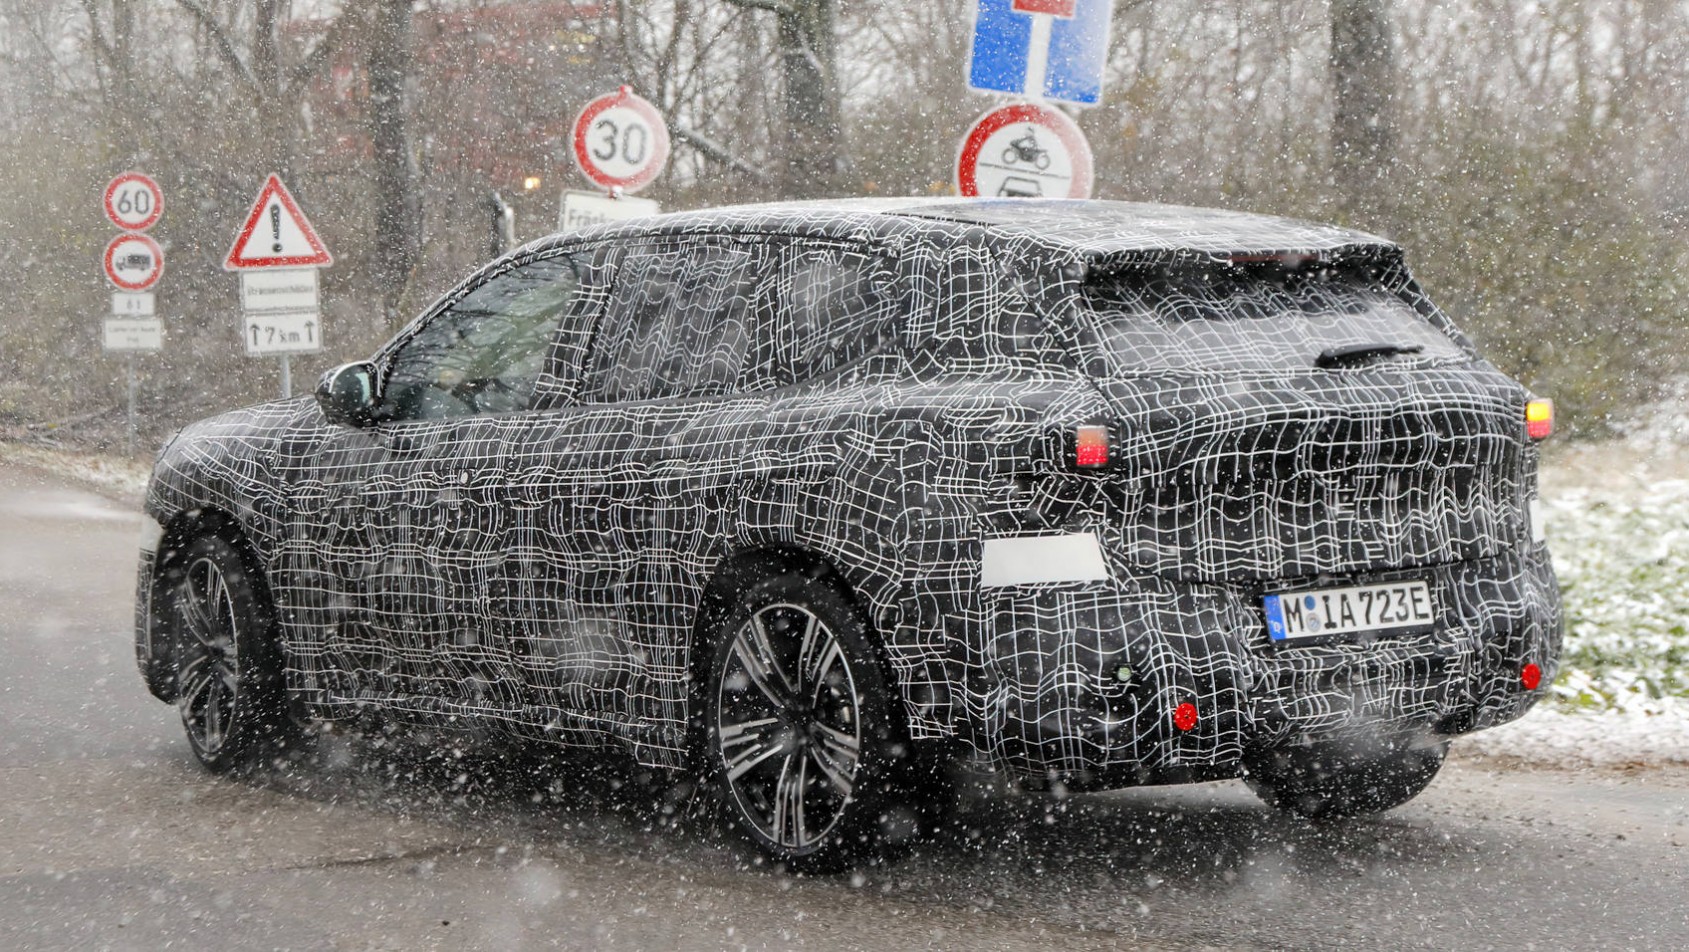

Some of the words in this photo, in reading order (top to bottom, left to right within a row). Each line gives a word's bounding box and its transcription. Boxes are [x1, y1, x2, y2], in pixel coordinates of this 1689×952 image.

[593, 120, 647, 165] 30
[117, 190, 149, 214] 60
[265, 326, 276, 345] 7
[280, 329, 301, 342] km
[1283, 597, 1304, 633] M
[1322, 593, 1356, 629] IA
[1358, 586, 1429, 625] 723E
